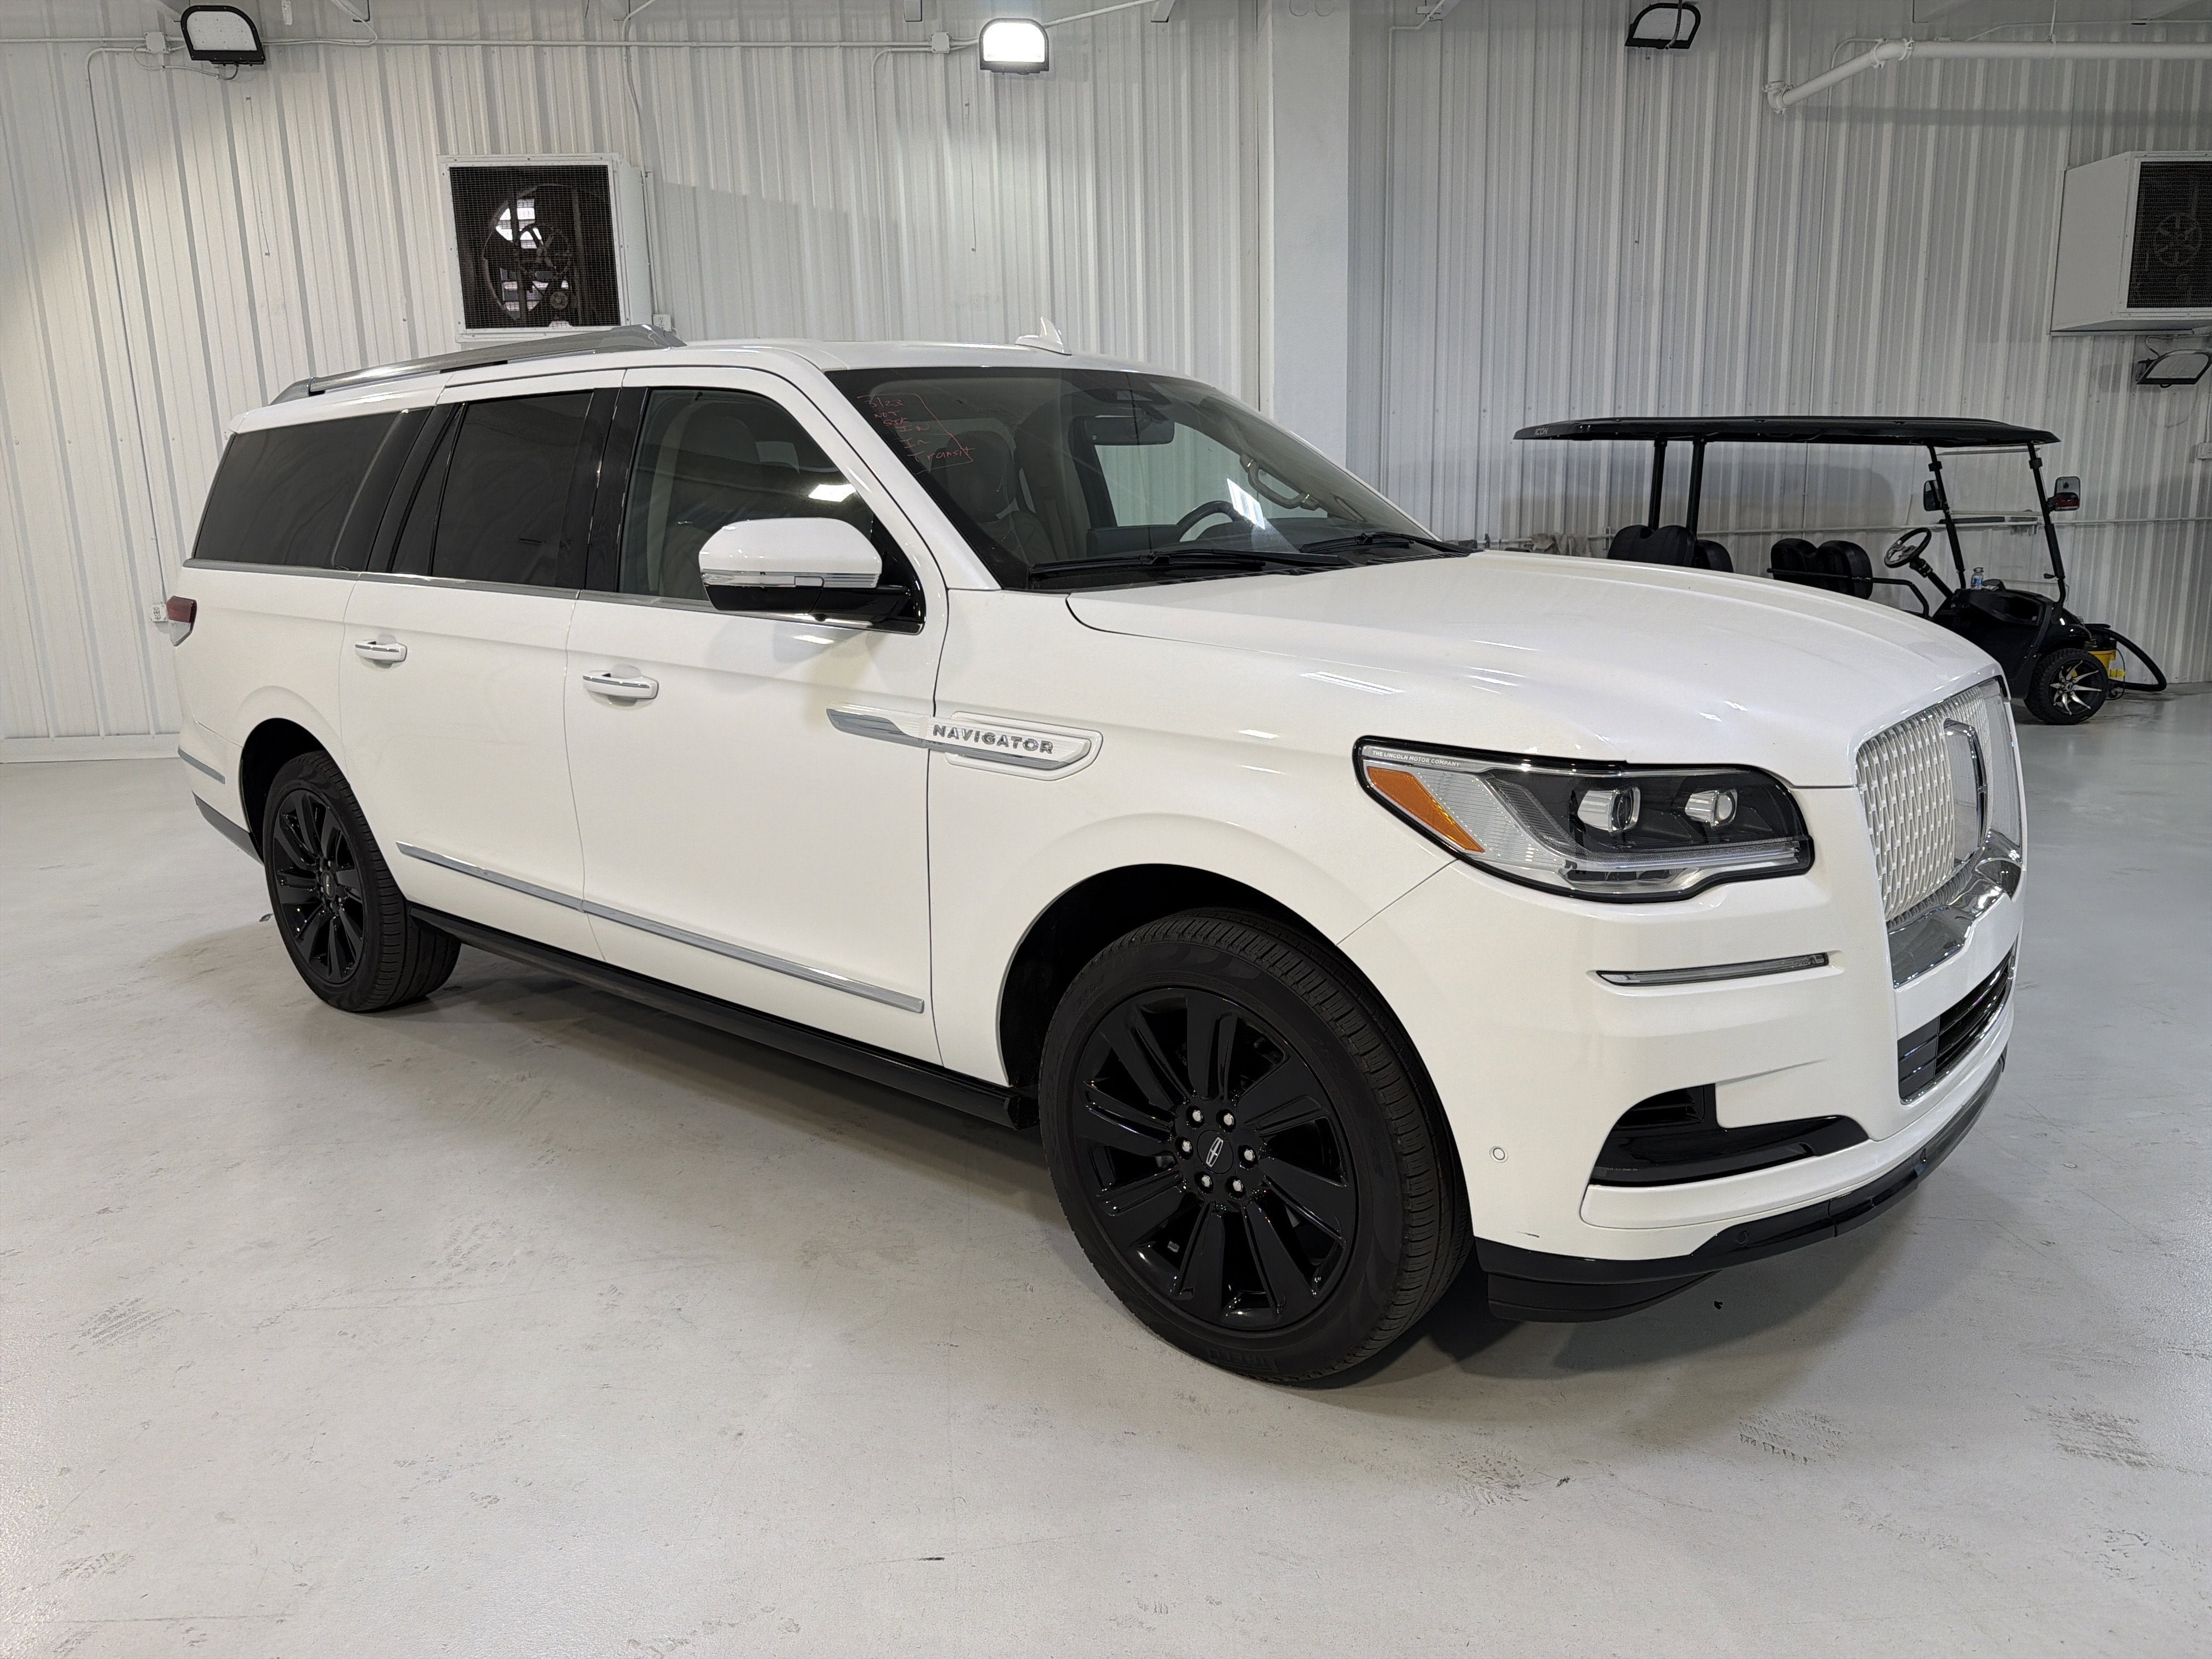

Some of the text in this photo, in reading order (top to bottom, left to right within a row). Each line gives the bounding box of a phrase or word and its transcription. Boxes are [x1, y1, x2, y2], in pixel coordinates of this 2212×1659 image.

[1534, 427, 1549, 436] ICON
[933, 724, 1053, 754] NAVIGATOR
[1384, 752, 1408, 760] LINCOLN
